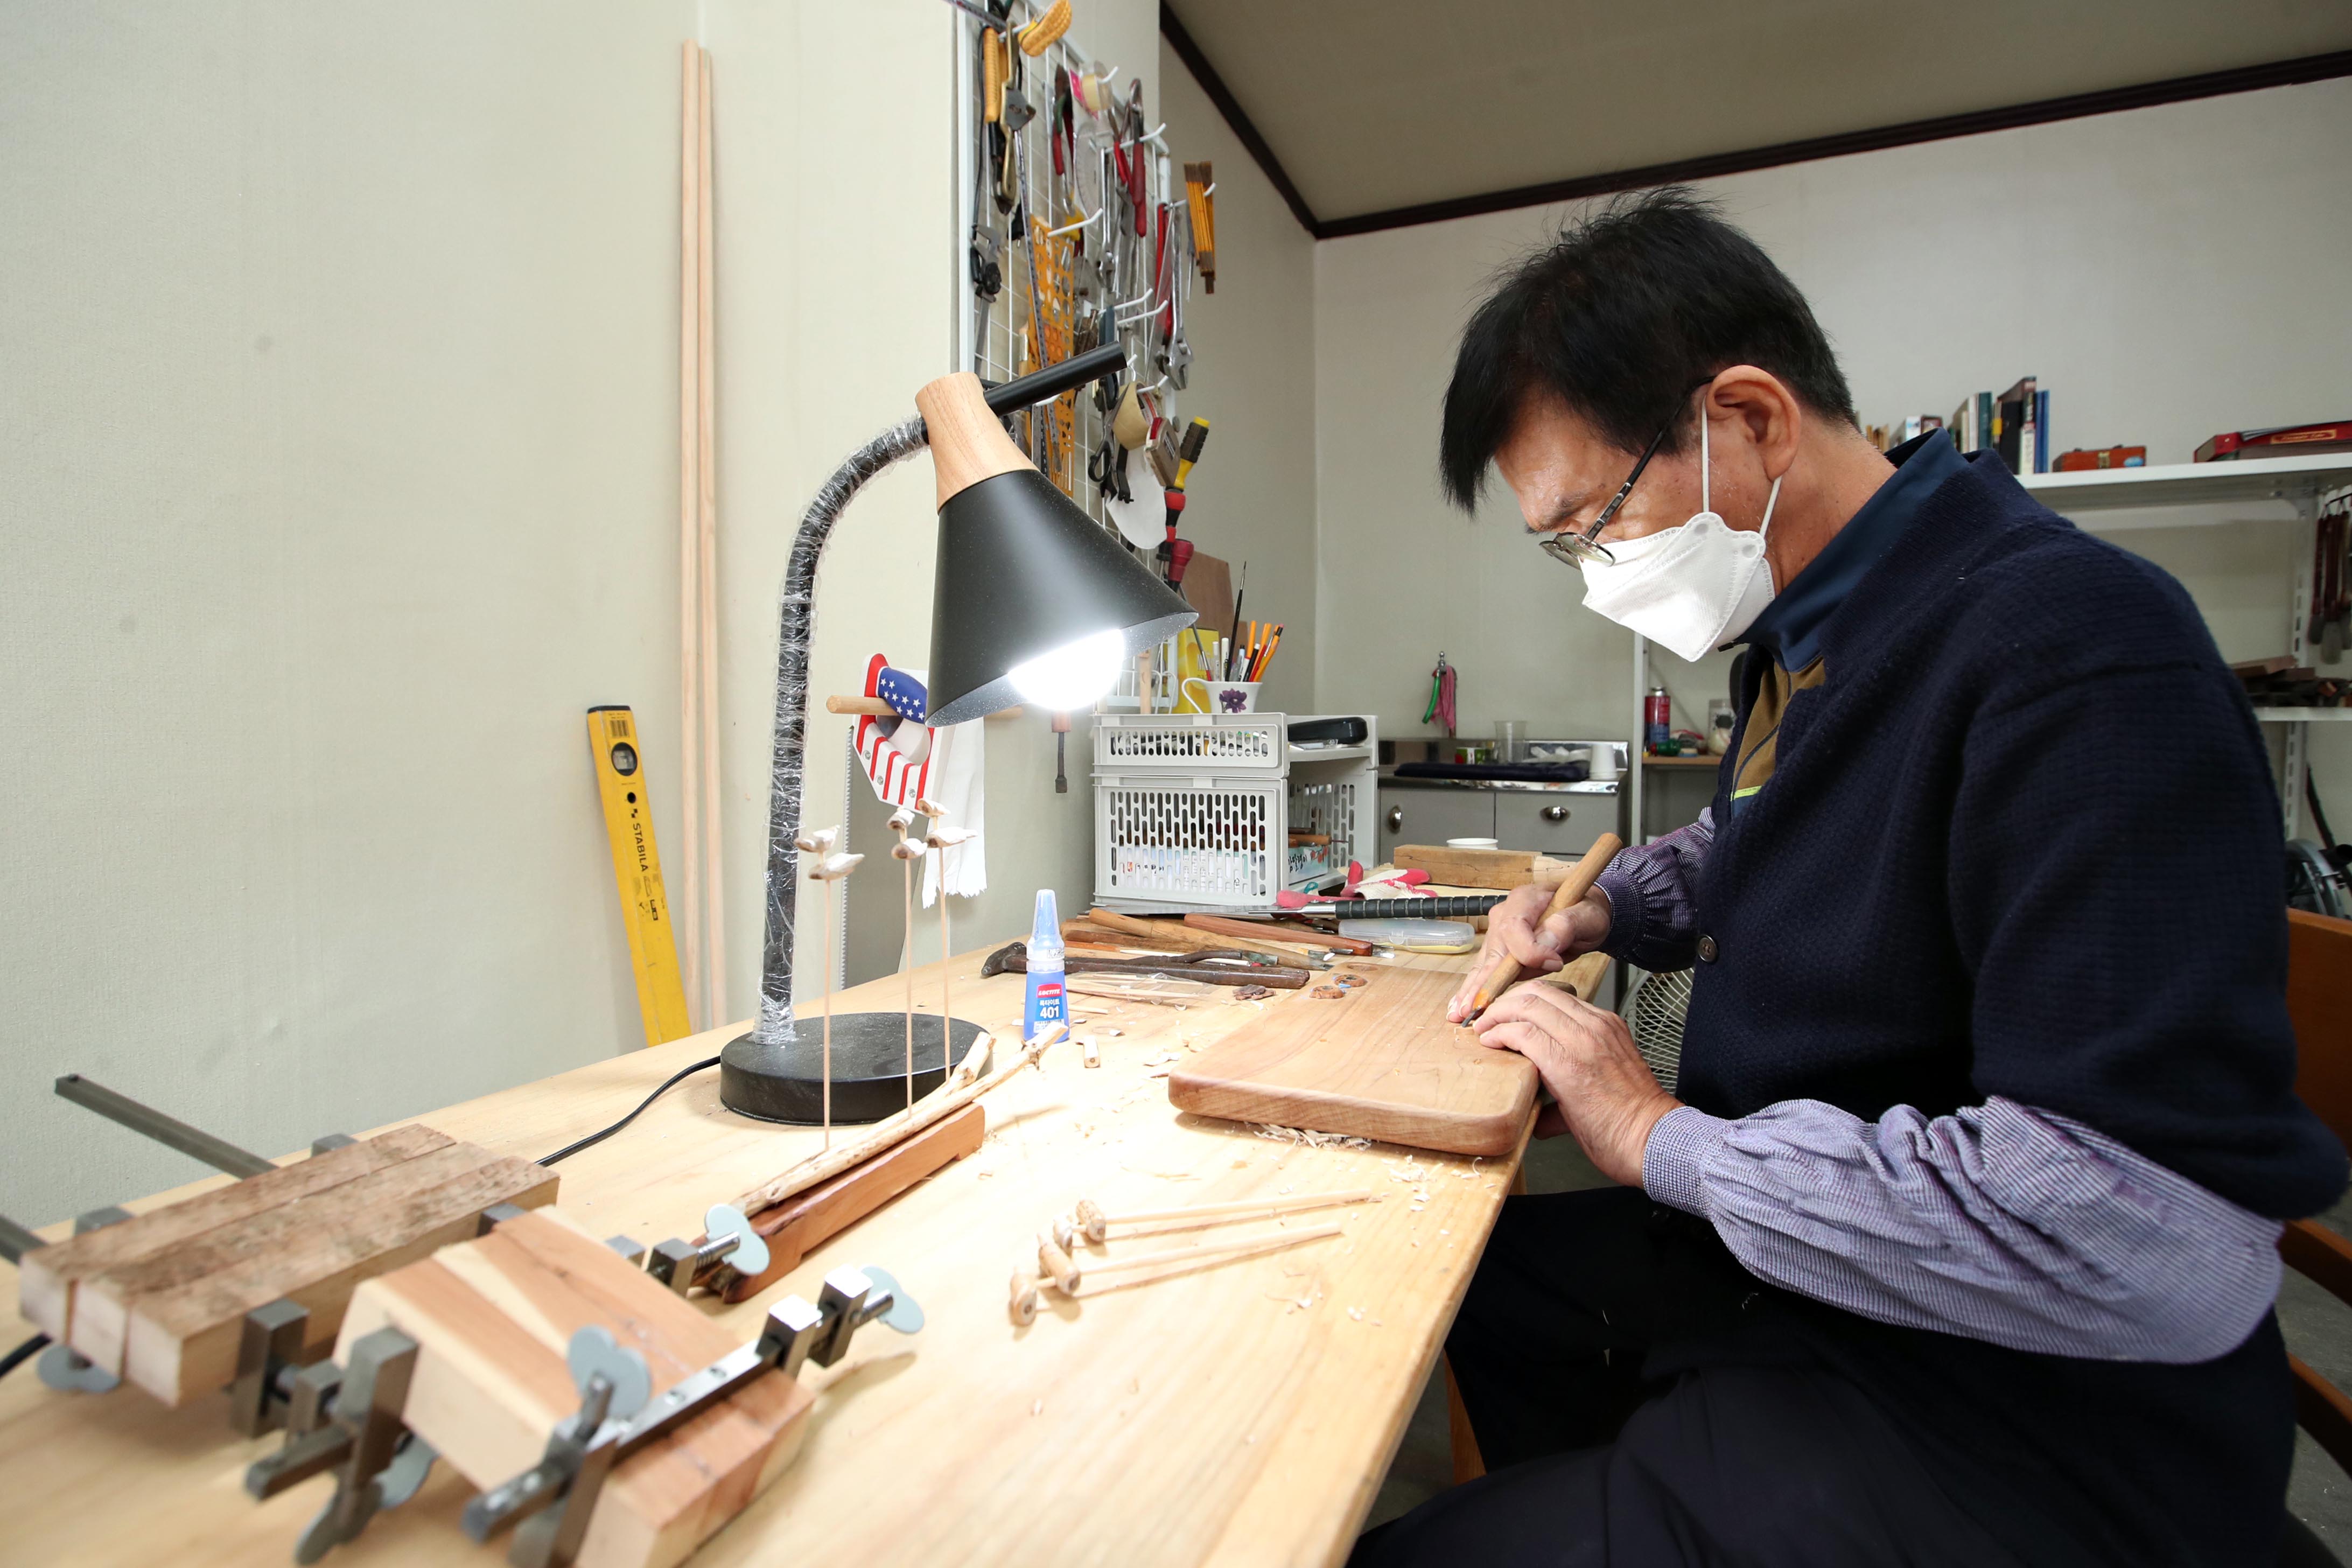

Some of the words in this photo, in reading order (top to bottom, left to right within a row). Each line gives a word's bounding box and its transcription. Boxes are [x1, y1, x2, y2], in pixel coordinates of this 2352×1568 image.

[633, 823, 649, 872] STABILA
[1039, 998, 1060, 1006] 록타이트
[1040, 1005, 1059, 1019] 401
